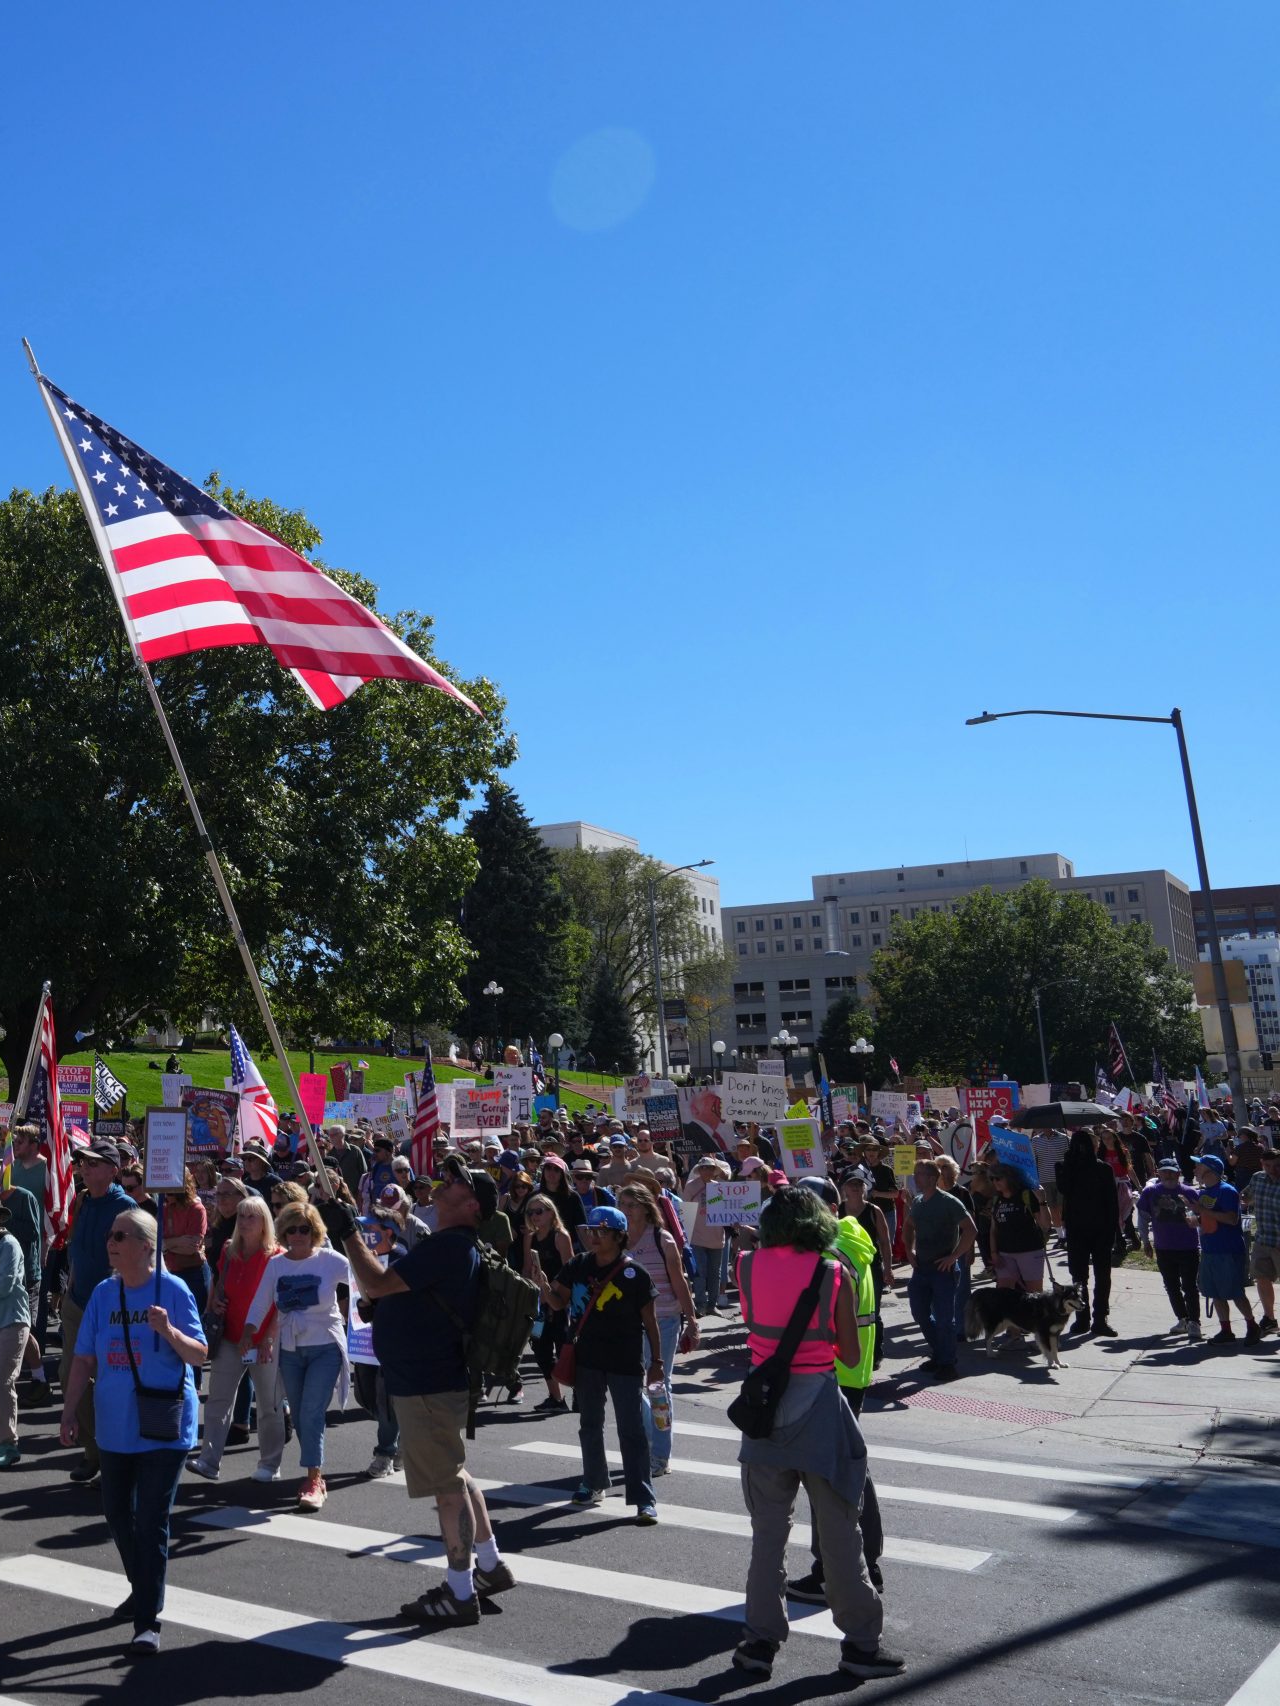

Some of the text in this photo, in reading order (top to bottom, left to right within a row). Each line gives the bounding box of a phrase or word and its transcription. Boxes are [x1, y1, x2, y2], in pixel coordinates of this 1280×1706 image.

[57, 1066, 84, 1075] STOP
[95, 1060, 121, 1092] FUCK
[59, 1075, 89, 1083] RUMP
[728, 1076, 756, 1092] Don't
[761, 1081, 785, 1100] bring
[969, 1089, 997, 1098] LOCK
[468, 1090, 502, 1104] Trump
[731, 1097, 781, 1108] back Nazi
[969, 1099, 992, 1108] HIM
[726, 1106, 769, 1120] Germany
[375, 1113, 400, 1126] ENOUGH
[477, 1115, 501, 1126] EVER
[992, 1136, 1014, 1150] SAVE
[717, 1184, 750, 1196] STOP
[723, 1199, 743, 1209] THE
